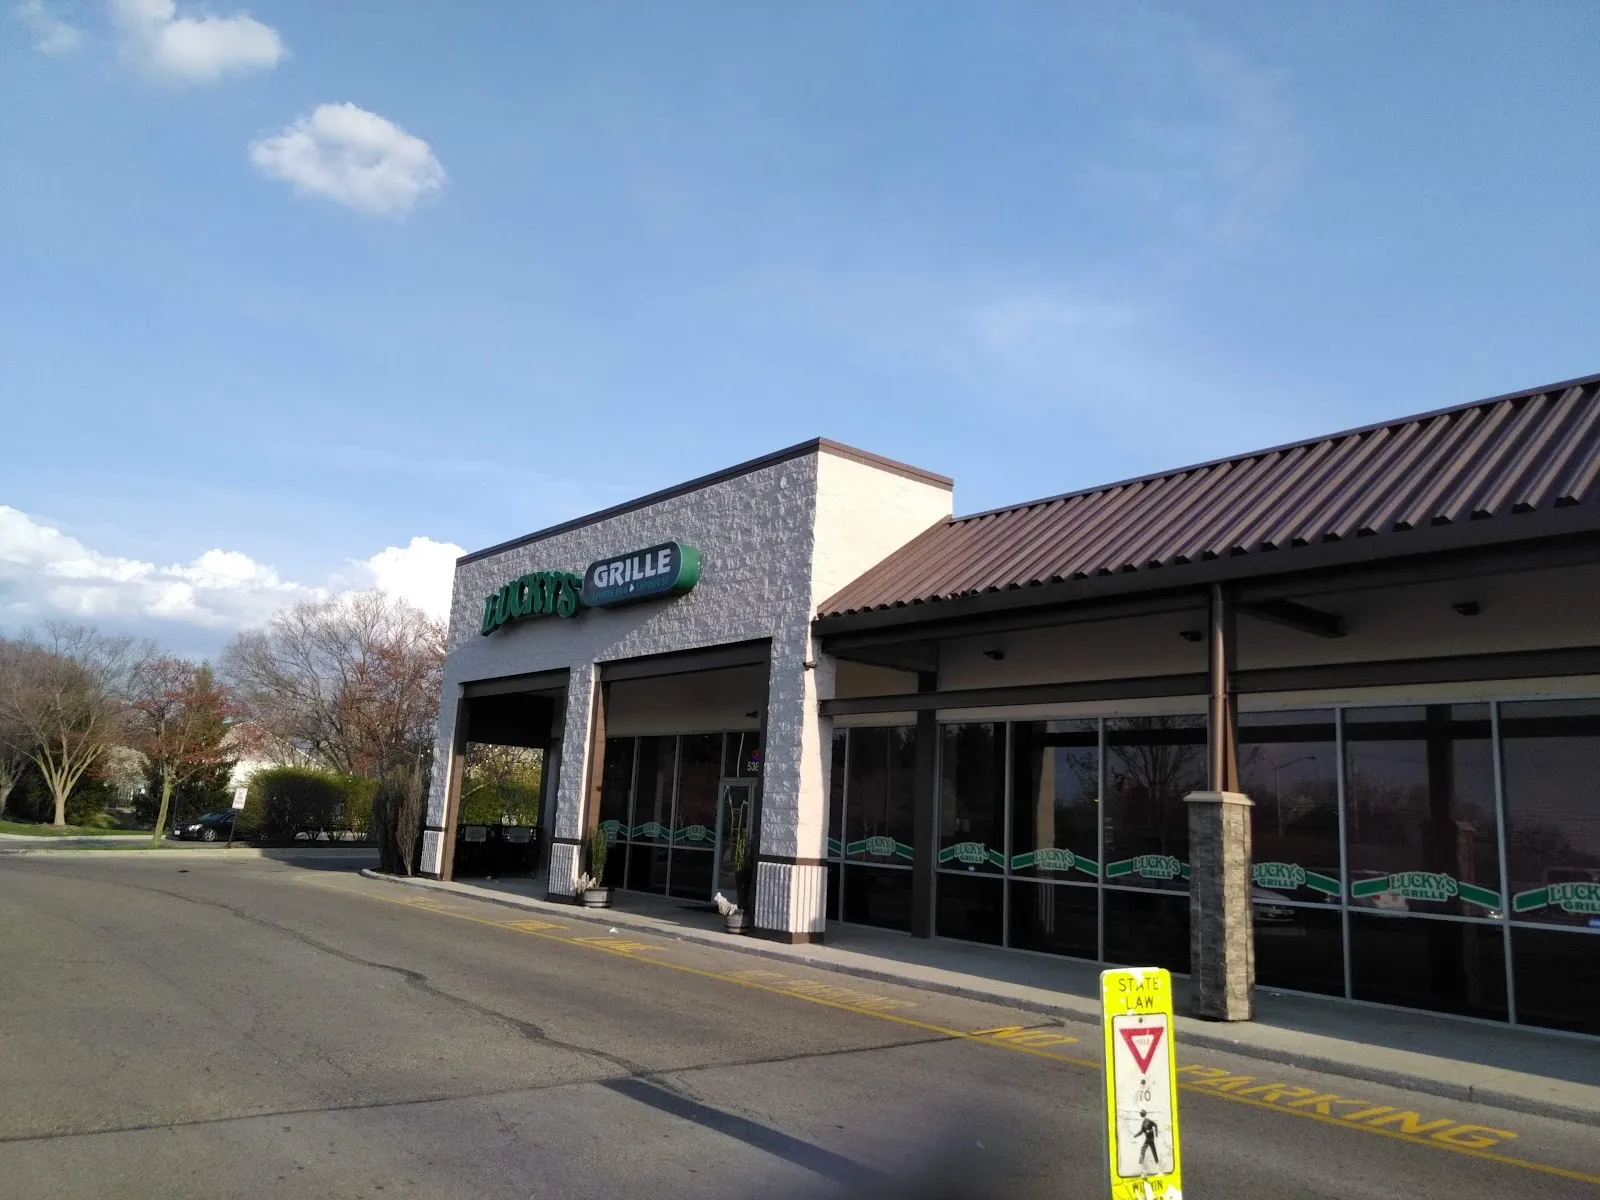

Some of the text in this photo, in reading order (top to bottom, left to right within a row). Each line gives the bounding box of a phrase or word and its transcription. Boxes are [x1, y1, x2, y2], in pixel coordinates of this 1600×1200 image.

[593, 548, 672, 588] GRILLE
[1134, 855, 1180, 876] LUCKY'S
[1141, 869, 1173, 878] GRILLE
[1258, 878, 1296, 888] GRILLE
[1389, 872, 1458, 894] LUCKY'S
[1401, 889, 1447, 899] GRILLE
[1118, 977, 1159, 992] STATE
[1126, 996, 1154, 1010] LAW
[968, 1026, 1519, 1149] NO PARKING
[1132, 1180, 1163, 1193] WIIN
